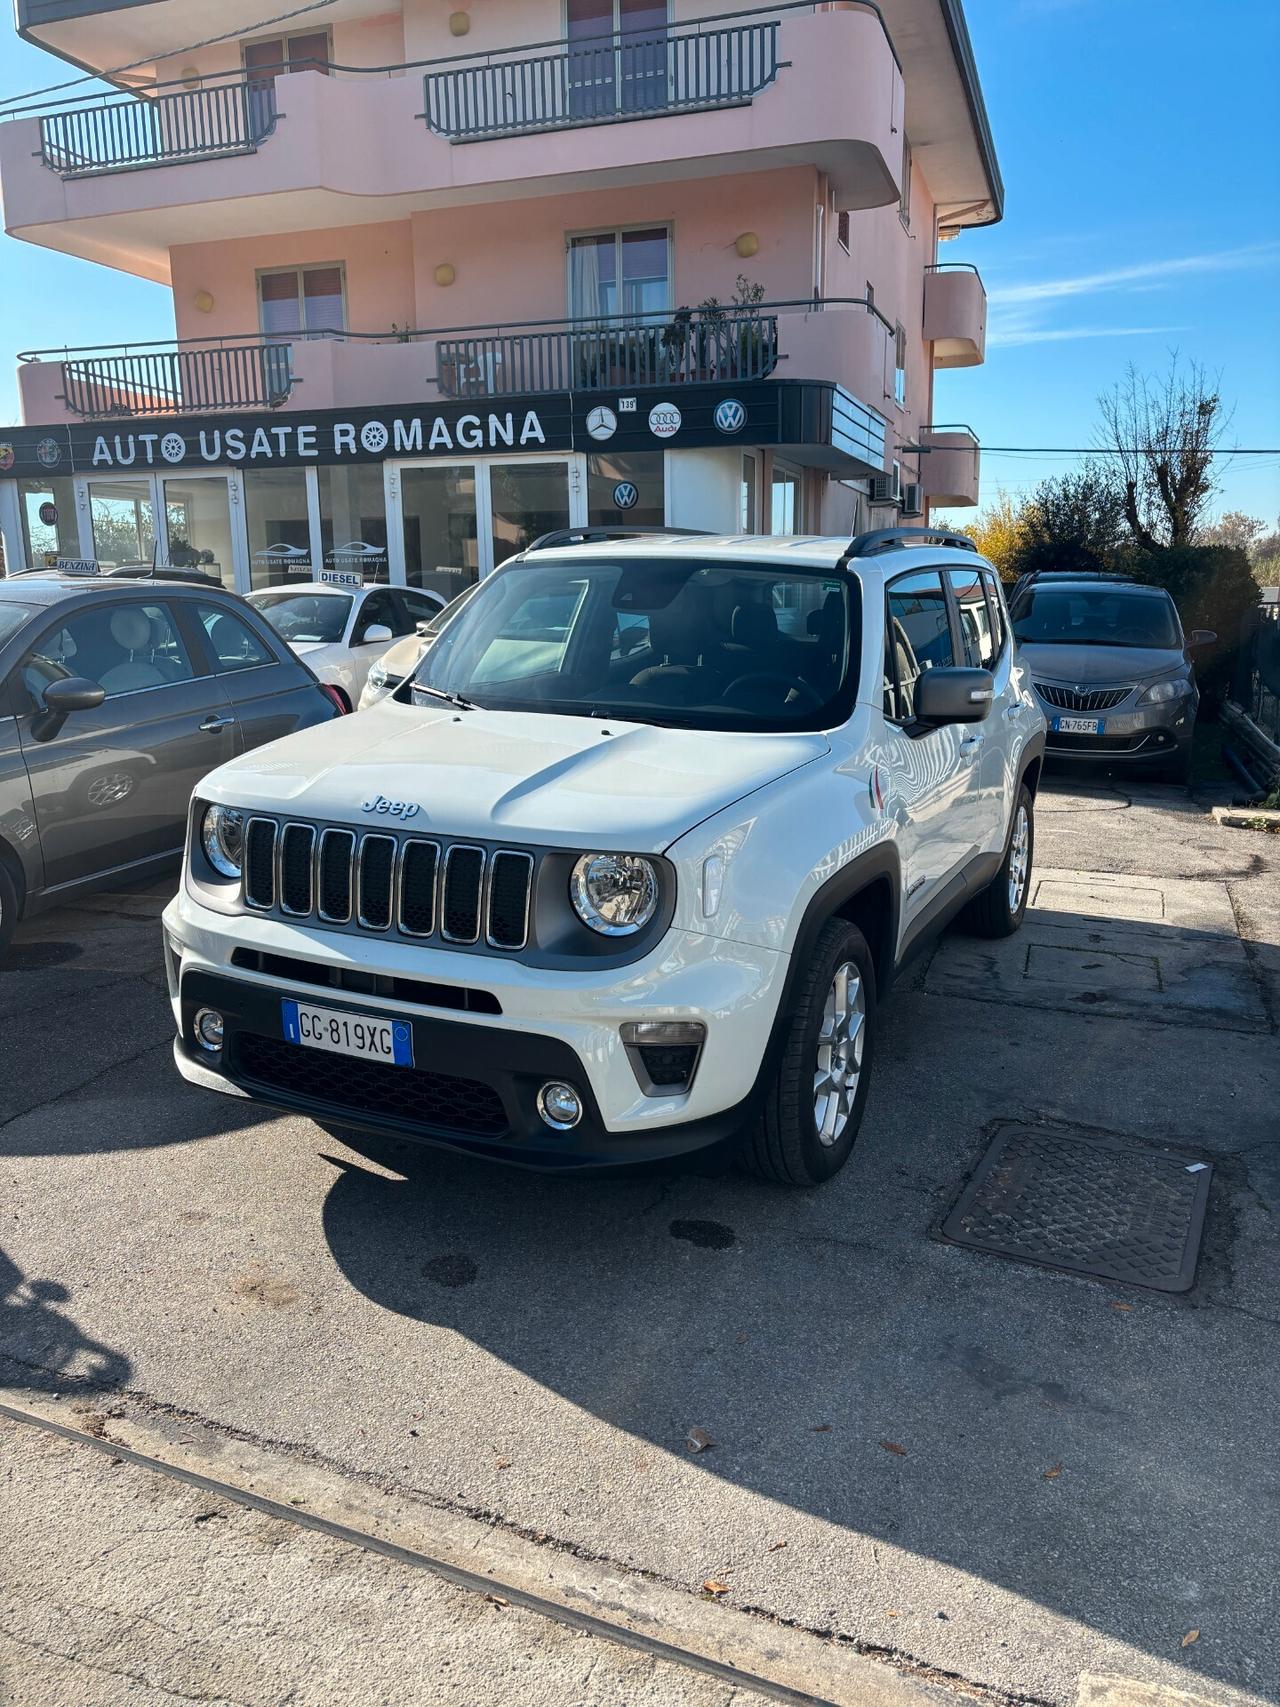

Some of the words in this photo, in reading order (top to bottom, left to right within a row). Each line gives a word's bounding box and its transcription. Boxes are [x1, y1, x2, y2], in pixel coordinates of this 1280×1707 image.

[653, 425, 678, 433] Audi
[92, 432, 187, 466] AUTO
[199, 424, 319, 462] USATE
[333, 410, 546, 456] ROMAGNA
[58, 560, 96, 571] BENZINA
[321, 572, 359, 585] DIESEL
[361, 794, 420, 820] Jeep
